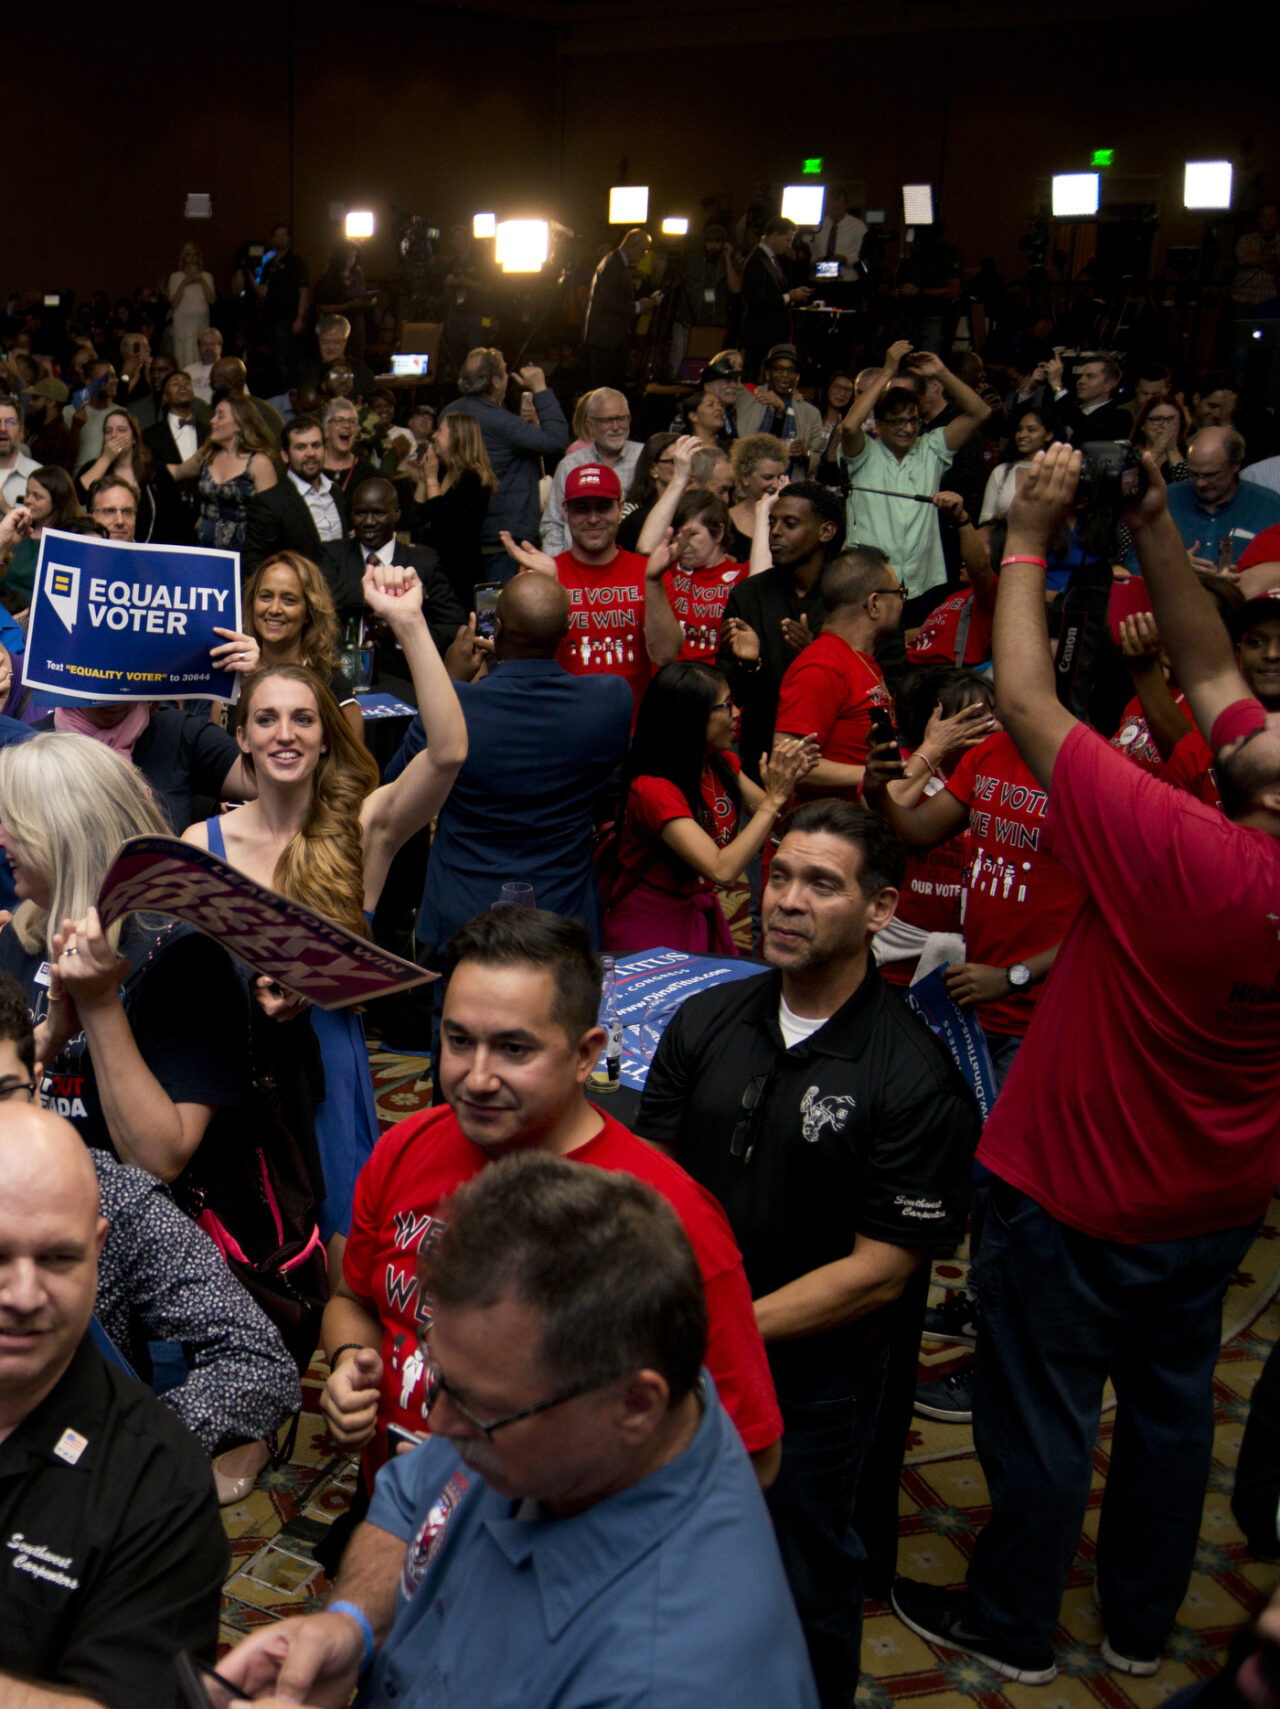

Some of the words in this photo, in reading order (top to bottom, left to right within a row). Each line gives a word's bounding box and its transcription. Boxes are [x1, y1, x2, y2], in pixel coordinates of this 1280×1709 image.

[89, 578, 229, 612] EQUALITY
[88, 603, 188, 635] VOTER
[1058, 627, 1078, 673] Canon
[46, 660, 64, 672] Text
[170, 674, 180, 682] to
[182, 673, 211, 682] 30644
[911, 879, 933, 896] OUR
[935, 883, 961, 898] VOTE
[283, 903, 347, 947] VOTE
[351, 945, 405, 974] WIN
